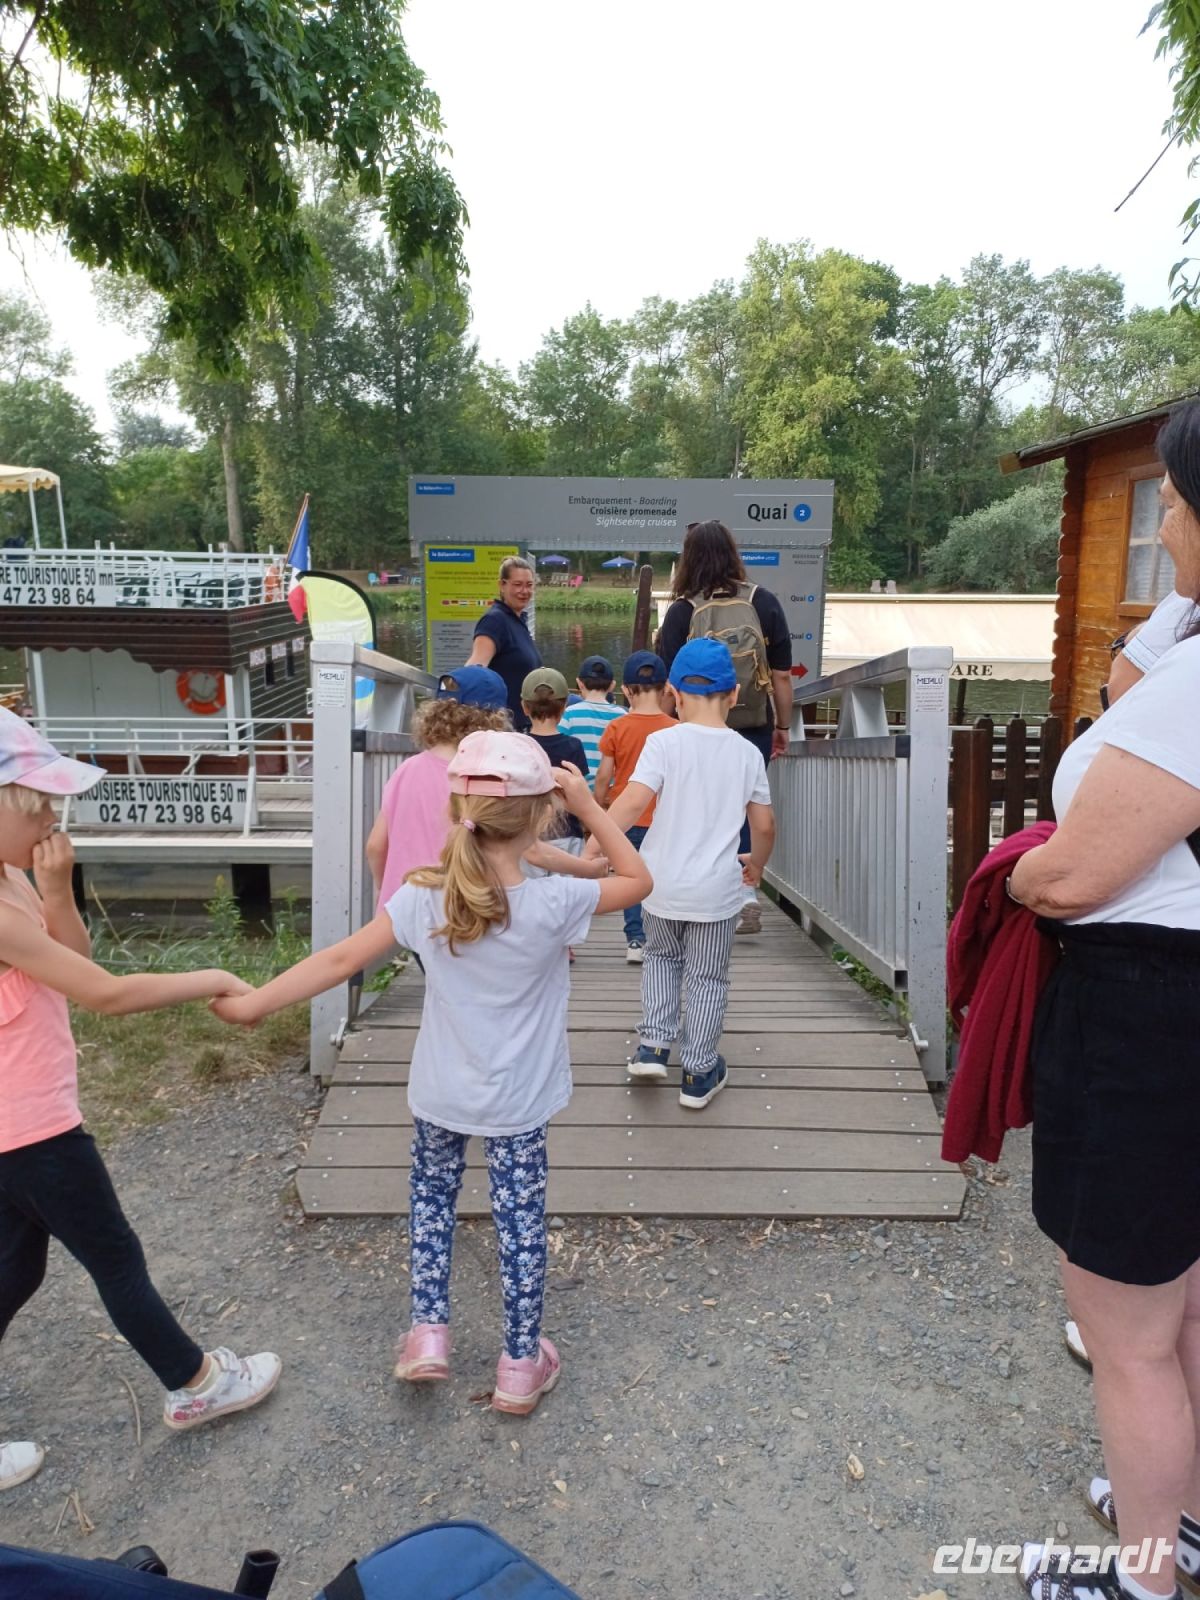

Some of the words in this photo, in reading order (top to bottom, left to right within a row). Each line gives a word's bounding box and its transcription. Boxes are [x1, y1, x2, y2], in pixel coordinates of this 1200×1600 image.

[568, 496, 632, 506] Embarquement
[640, 496, 678, 507] Boarding
[590, 506, 628, 515] Croisière
[629, 507, 677, 517] promenade
[747, 503, 788, 522] Quai
[595, 516, 646, 528] Sightseeing
[647, 518, 677, 527] cruises
[14, 567, 82, 586] TOURISTIQUE
[84, 567, 97, 586] 50
[99, 573, 114, 586] mn
[3, 586, 22, 605] 47
[27, 587, 47, 605] 23
[51, 587, 71, 605] 98
[76, 587, 96, 606] 64
[77, 781, 136, 801] OISIERE
[138, 782, 217, 802] TOURISTIQUE
[220, 783, 234, 802] 50
[236, 788, 247, 803] m
[99, 803, 122, 823] 02
[127, 803, 148, 823] 47
[155, 804, 177, 823] 23
[183, 804, 205, 824] 98
[210, 805, 233, 824] 64
